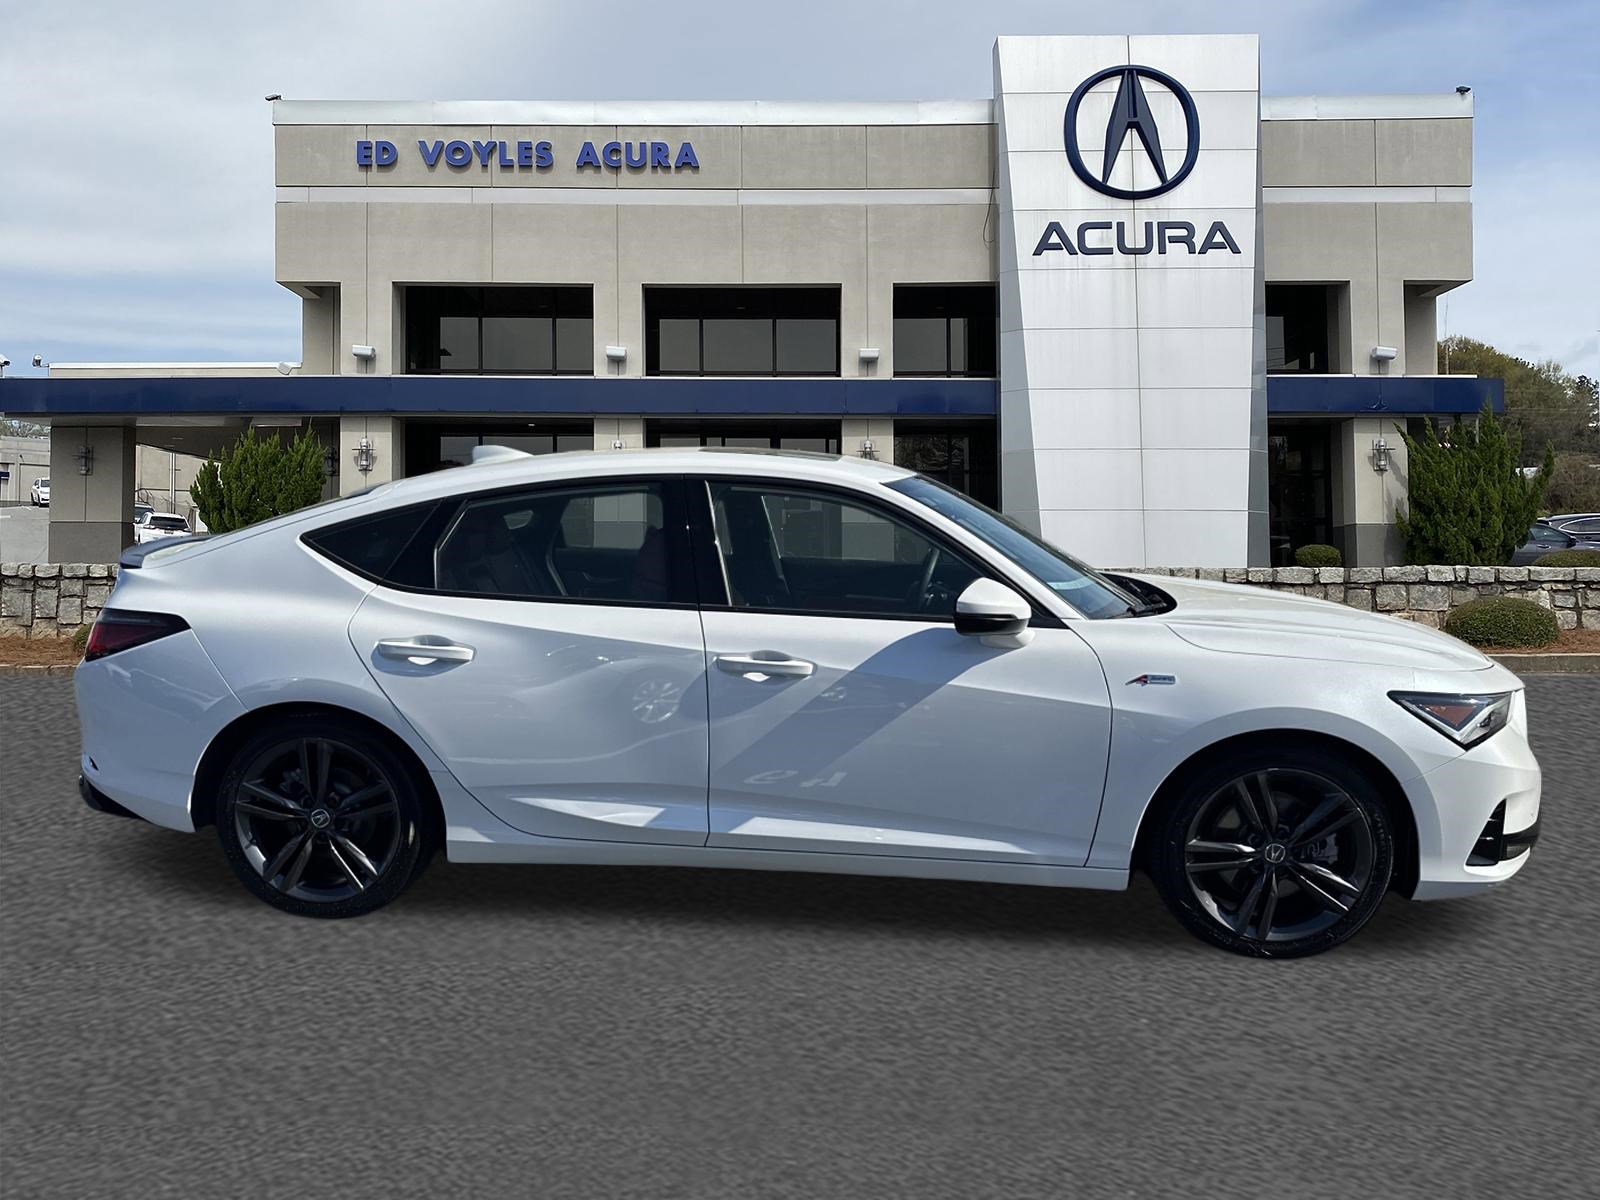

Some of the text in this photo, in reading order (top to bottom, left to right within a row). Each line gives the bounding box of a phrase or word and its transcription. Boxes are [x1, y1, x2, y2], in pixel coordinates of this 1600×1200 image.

[356, 140, 700, 168] ED VOYLES ACURA
[1032, 221, 1242, 255] ACURA
